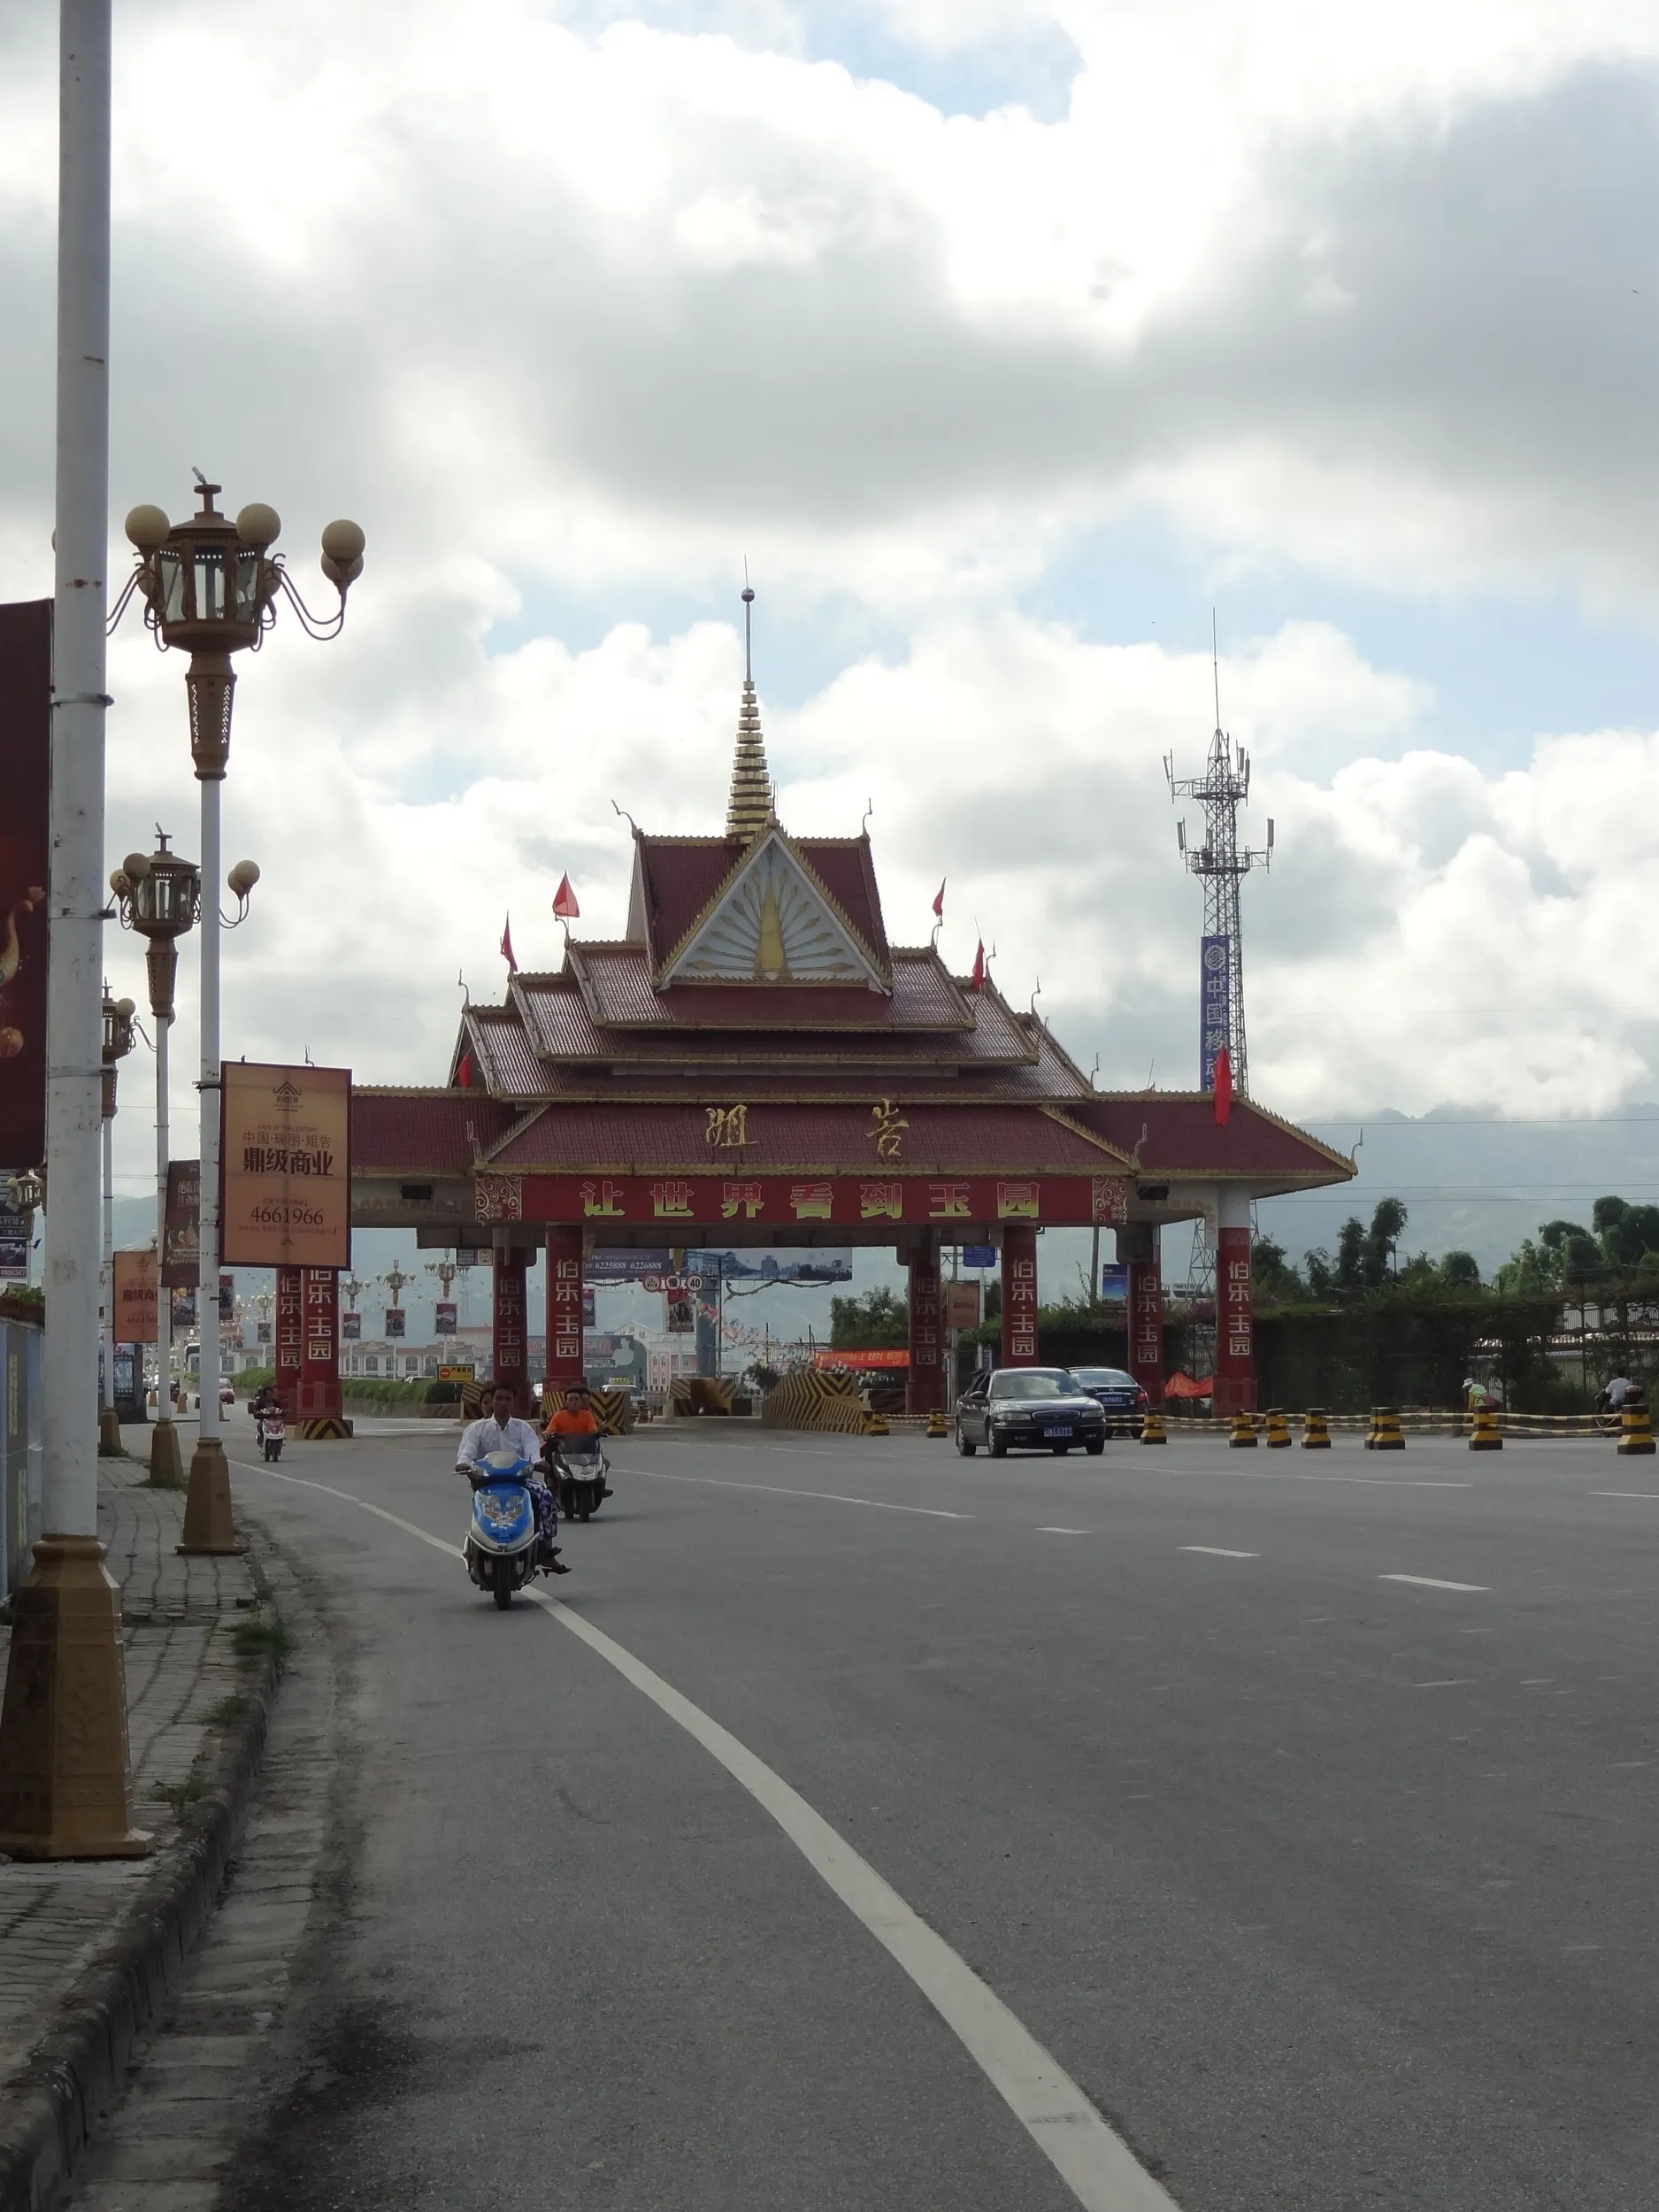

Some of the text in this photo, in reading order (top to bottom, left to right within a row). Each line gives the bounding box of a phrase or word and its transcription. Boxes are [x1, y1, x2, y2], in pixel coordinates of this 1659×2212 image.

[243, 1147, 334, 1176] 鼎级商业
[580, 1180, 1041, 1219] 让世界看到玉园
[250, 1206, 324, 1225] 4661966
[690, 1279, 700, 1287] 40
[123, 1289, 157, 1302] 鼎级商
